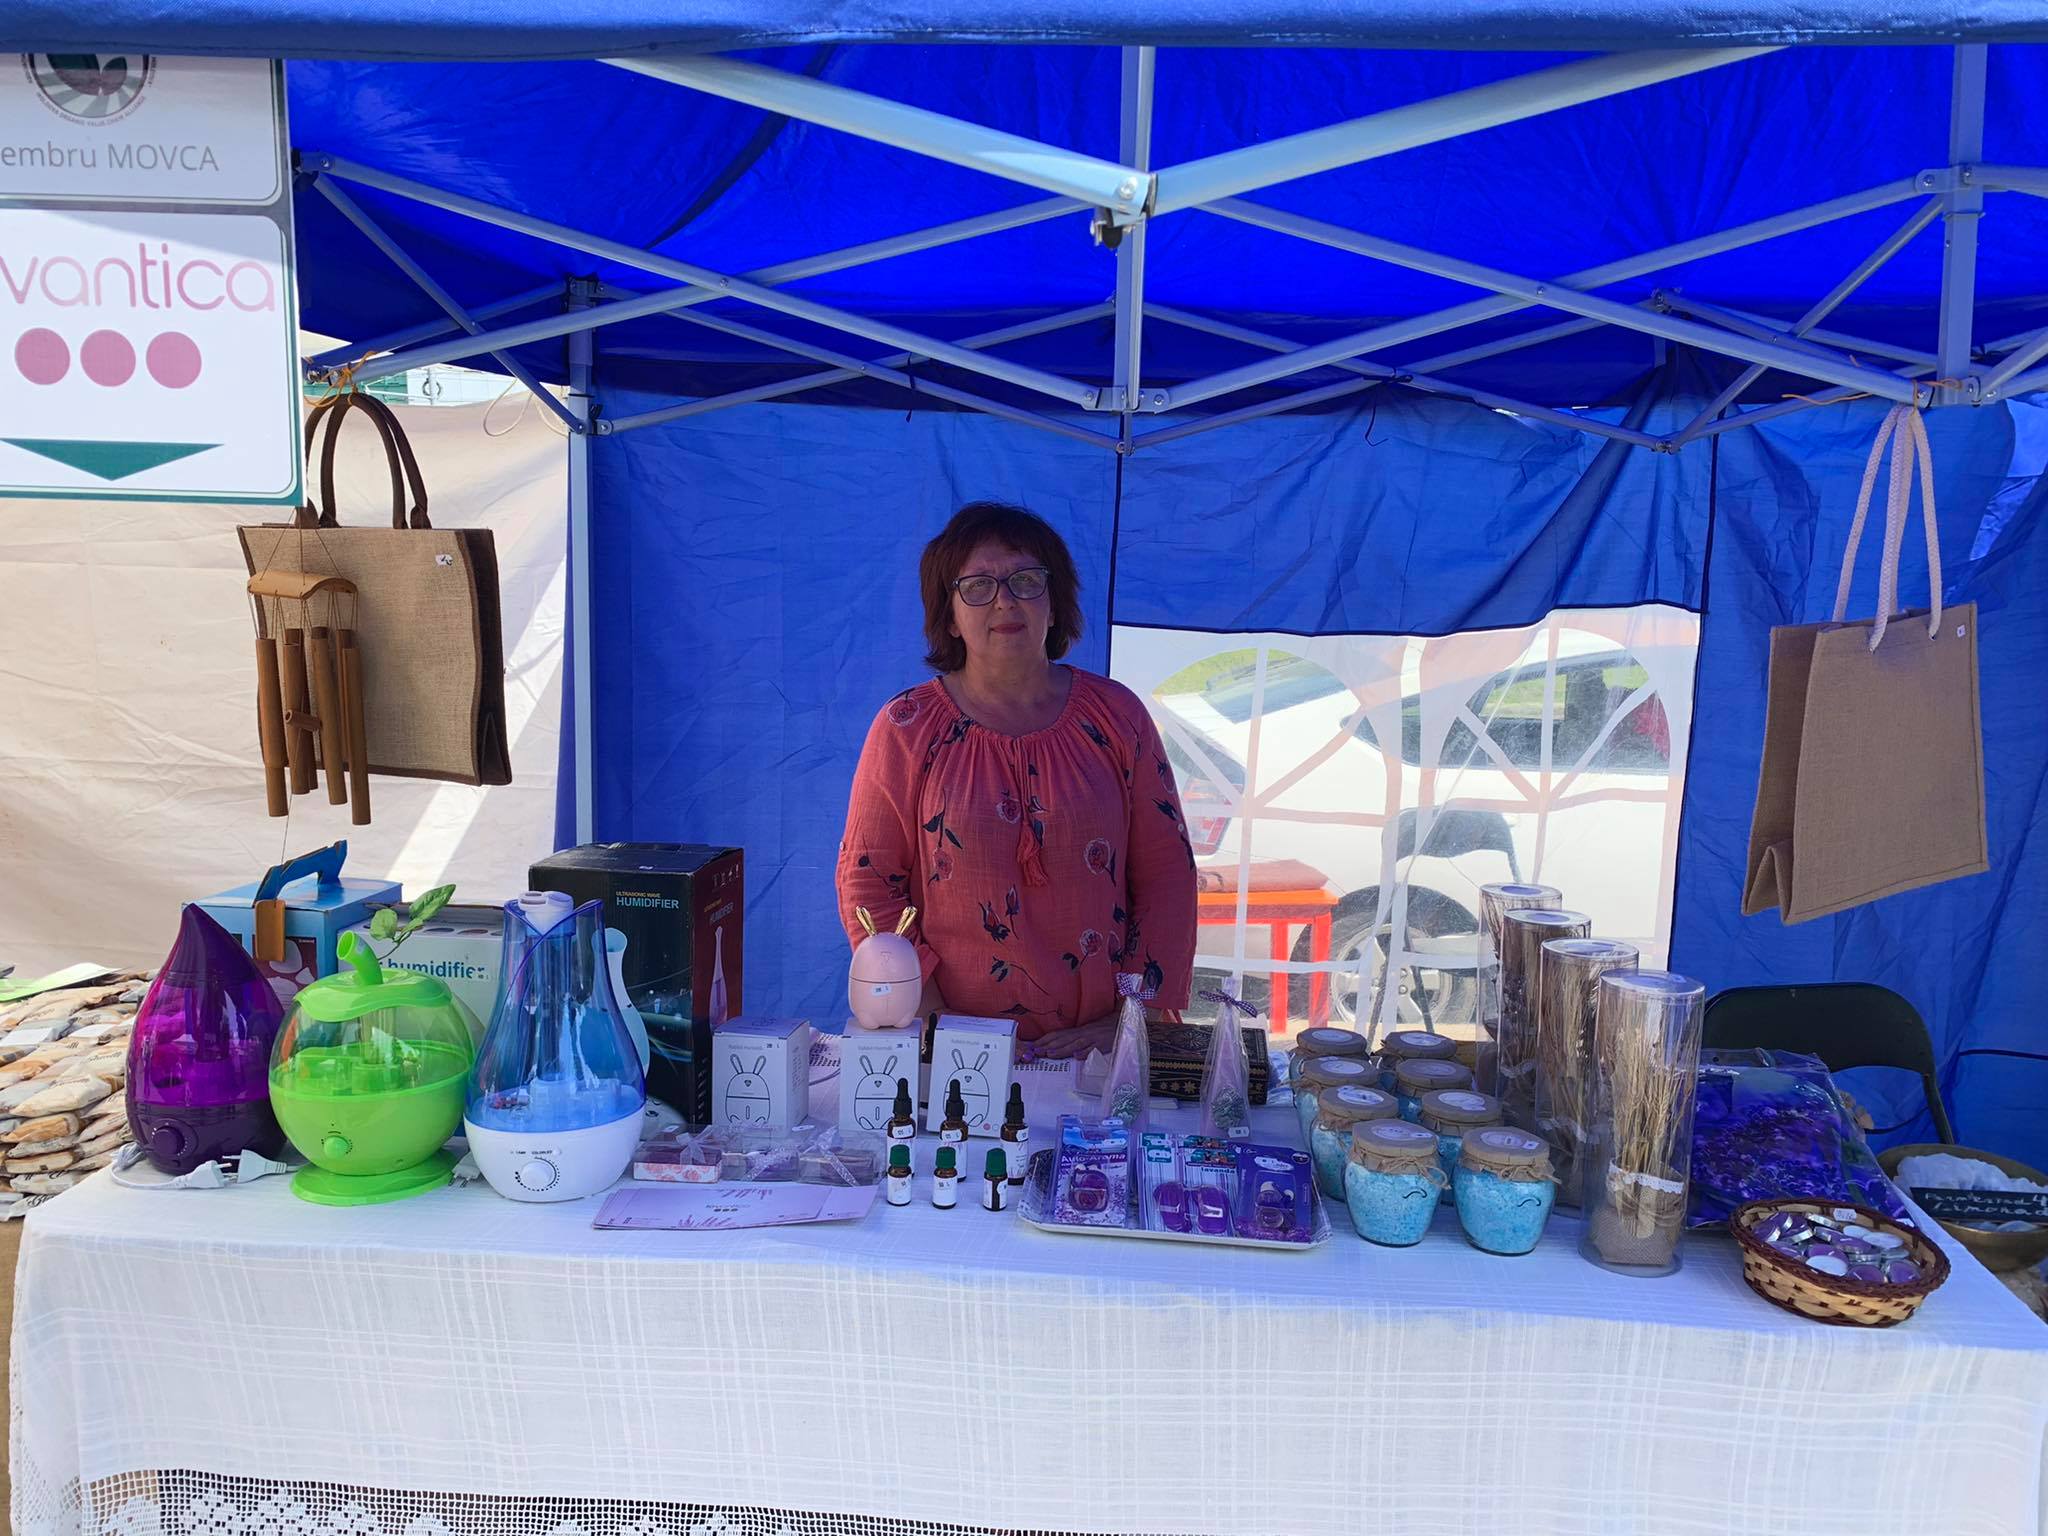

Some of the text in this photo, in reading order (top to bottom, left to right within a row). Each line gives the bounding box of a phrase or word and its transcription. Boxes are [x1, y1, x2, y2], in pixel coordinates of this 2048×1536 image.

[1, 141, 220, 172] embru MOVCA
[0, 242, 275, 312] vantica
[616, 897, 680, 909] HUMIDIFIER
[1202, 1166, 1235, 1174] lavanda
